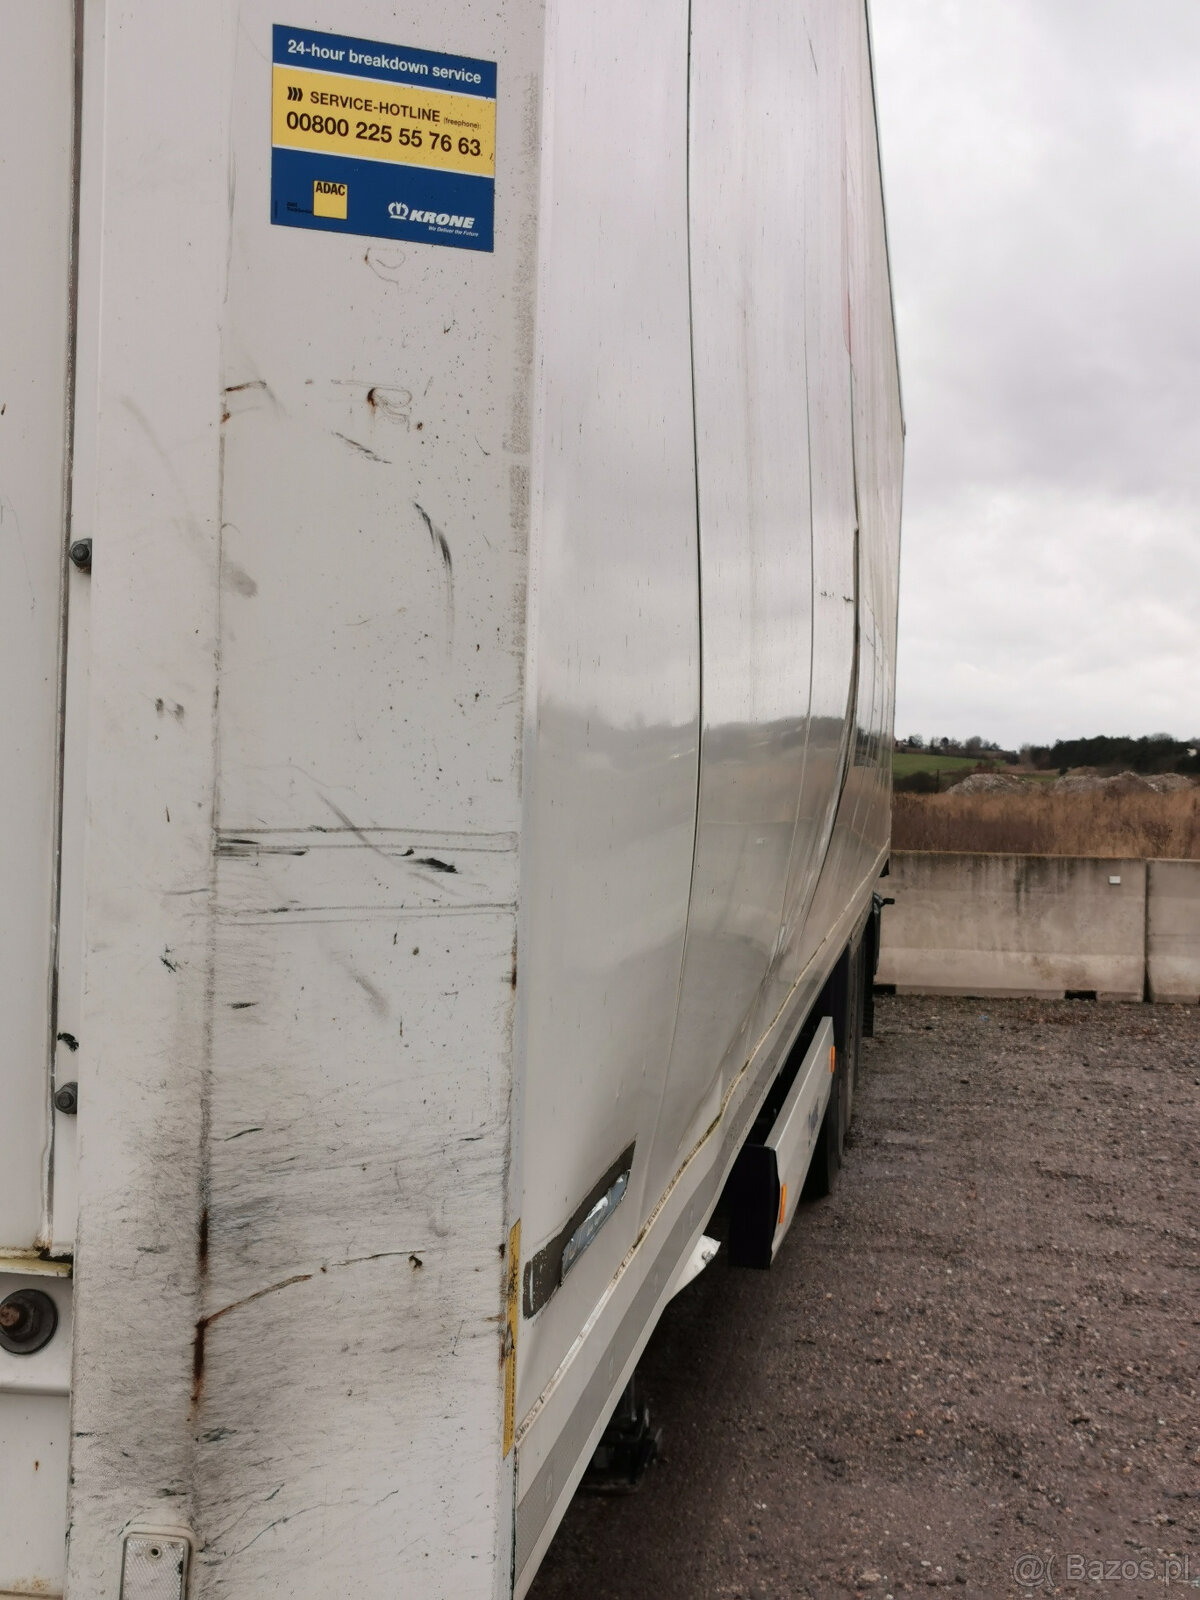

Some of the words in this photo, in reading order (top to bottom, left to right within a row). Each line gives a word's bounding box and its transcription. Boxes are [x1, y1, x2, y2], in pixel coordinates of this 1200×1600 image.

[287, 39, 346, 62] 24-hour
[348, 49, 429, 75] breakdown
[432, 65, 482, 84] service
[310, 91, 441, 123] SERVICE-HOTLINE
[286, 111, 349, 137] 00800
[355, 122, 393, 143] 225
[398, 129, 423, 148] 55
[428, 131, 452, 152] 76
[458, 137, 481, 157] 63
[315, 181, 346, 196] ADAC
[409, 209, 475, 229] KRONE
[437, 226, 454, 234] Deliver
